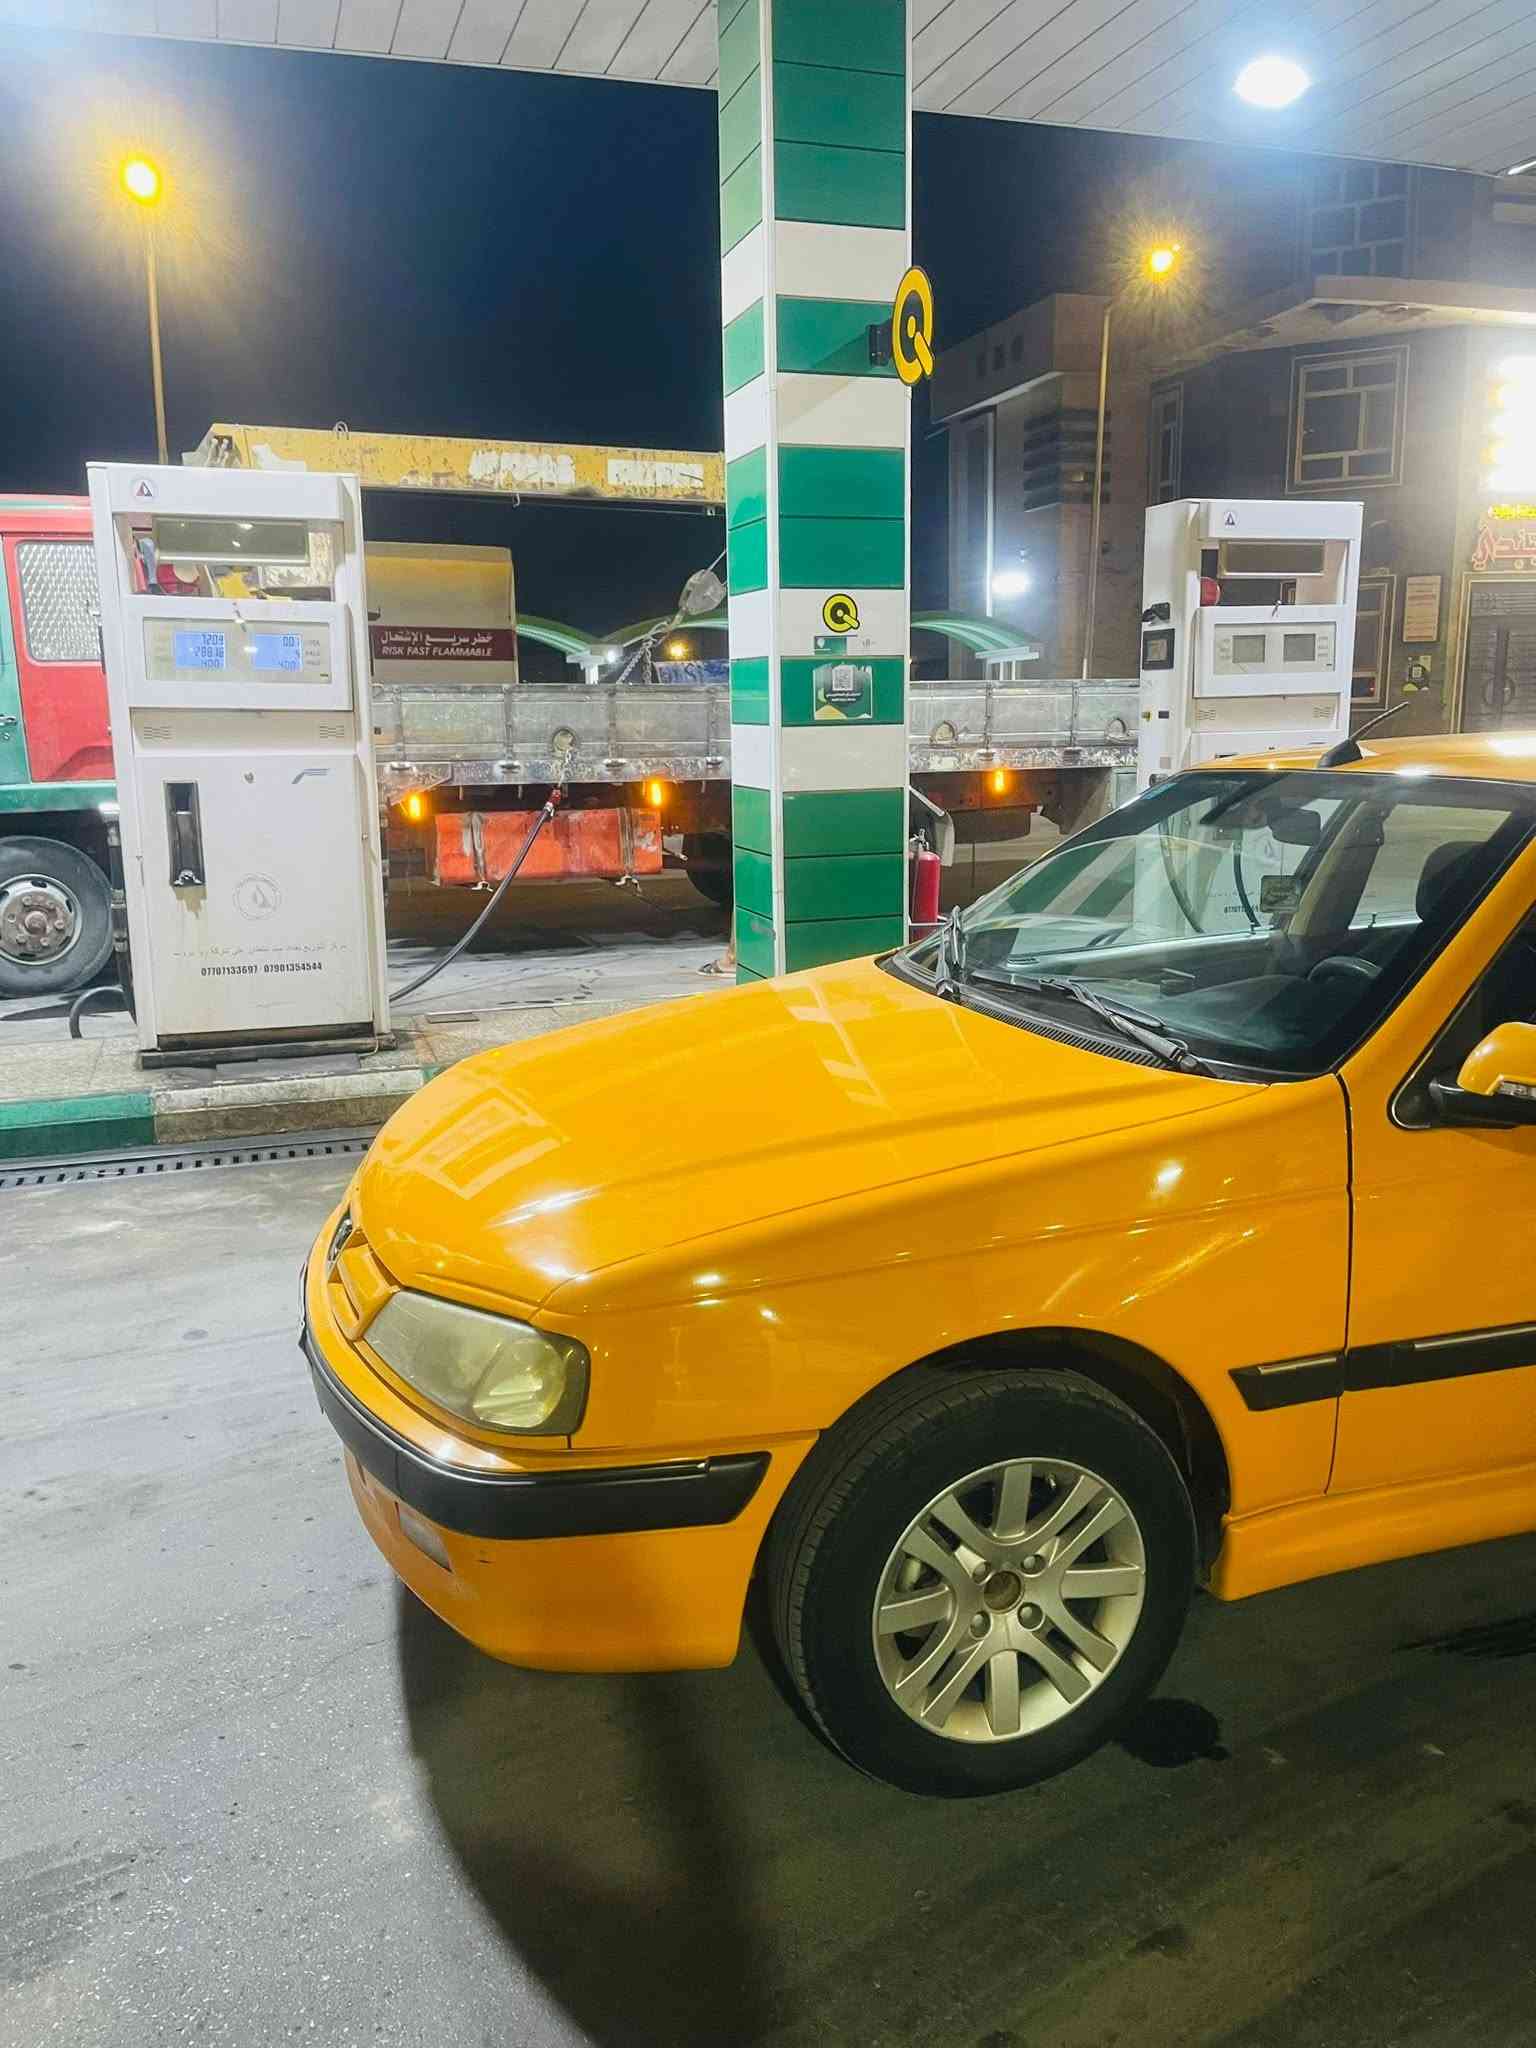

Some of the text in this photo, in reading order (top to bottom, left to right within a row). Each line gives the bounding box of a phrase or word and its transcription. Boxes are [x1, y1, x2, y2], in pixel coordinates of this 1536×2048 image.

[382, 646, 493, 657] RISK FAST FLAMMABLE
